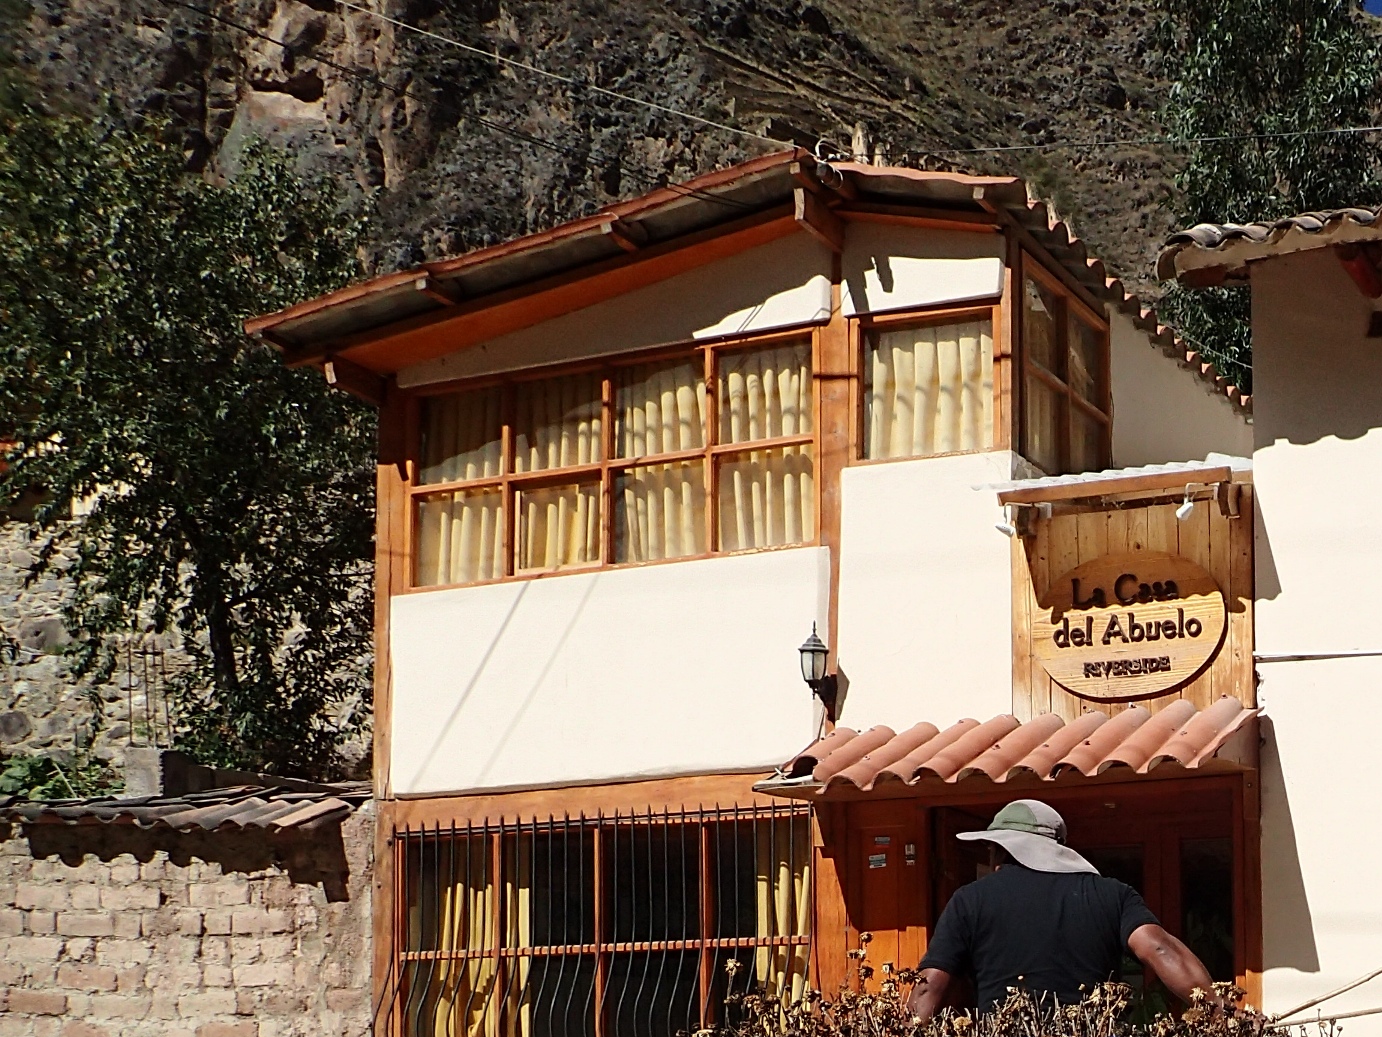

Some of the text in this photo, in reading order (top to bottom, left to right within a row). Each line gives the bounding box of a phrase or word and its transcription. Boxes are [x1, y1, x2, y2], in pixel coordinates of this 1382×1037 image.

[1071, 573, 1180, 610] La Casa
[1053, 607, 1203, 648] del Abuelo
[1083, 655, 1172, 680] RIVERSIDE
